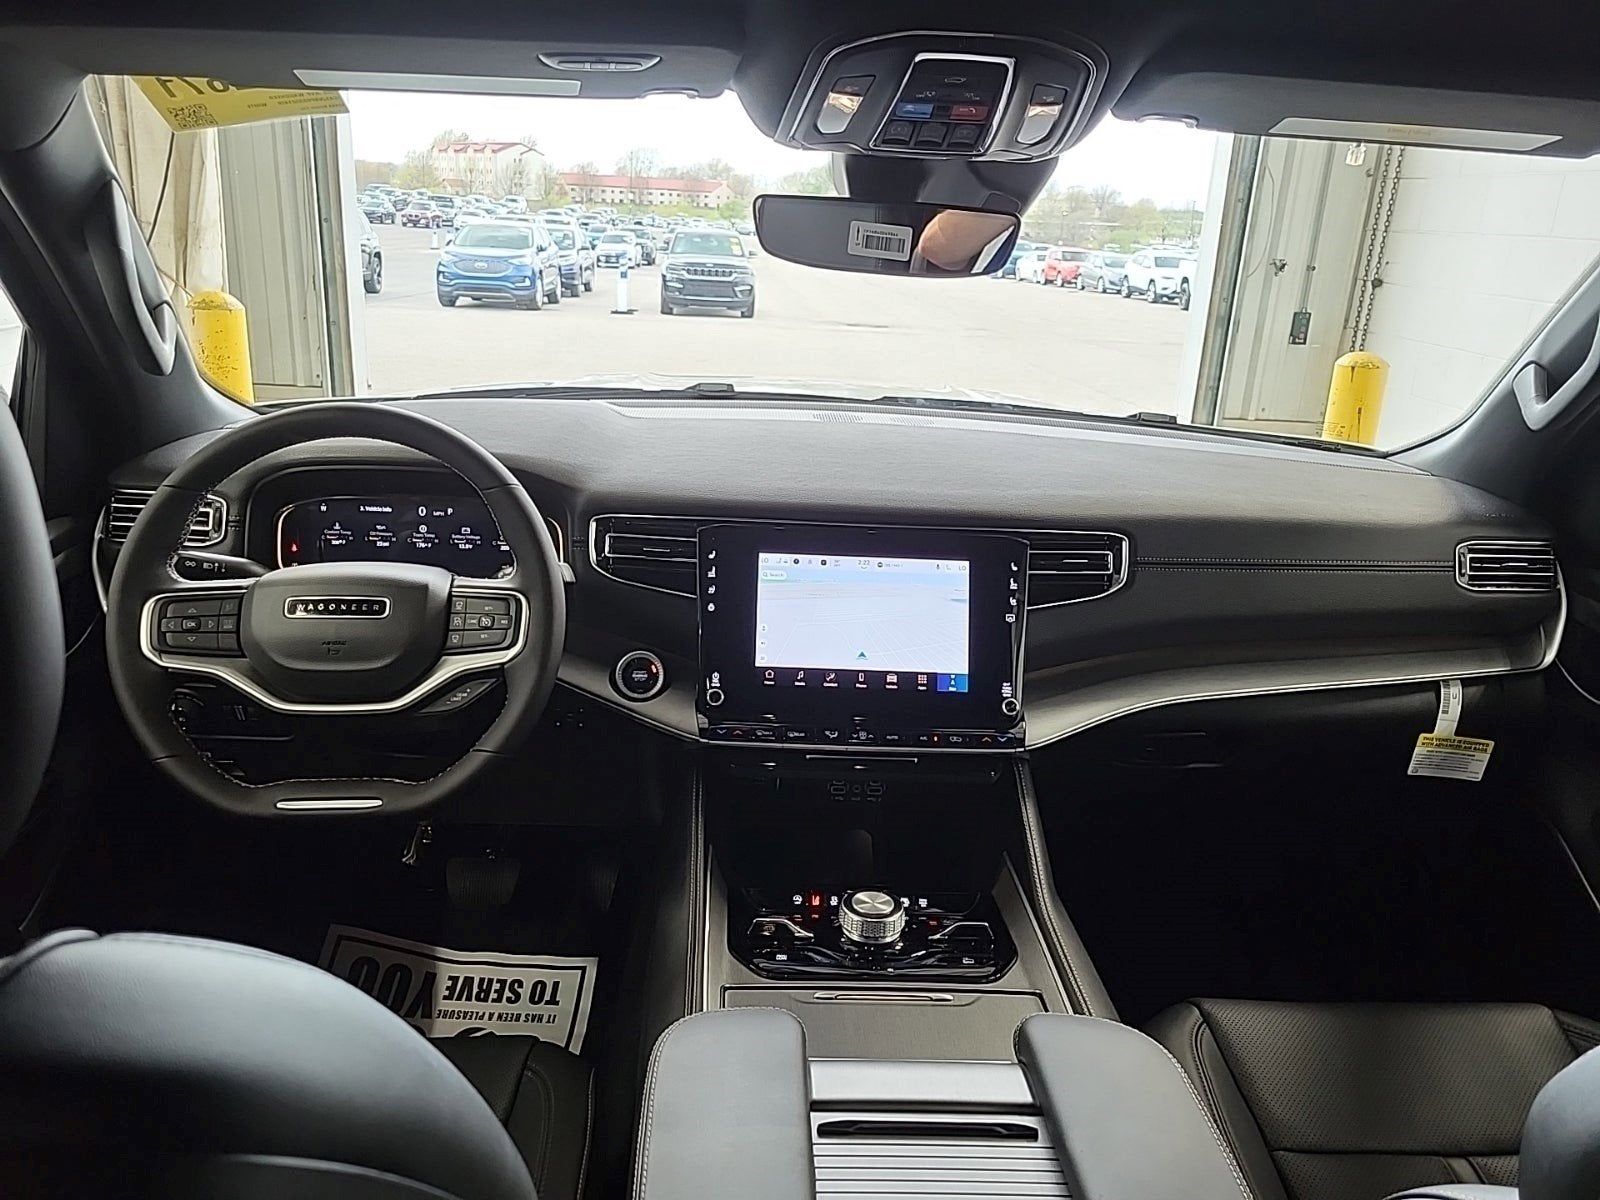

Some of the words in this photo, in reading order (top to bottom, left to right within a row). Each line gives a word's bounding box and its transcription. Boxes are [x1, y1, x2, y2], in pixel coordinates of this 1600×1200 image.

[418, 506, 427, 517] 0
[447, 507, 454, 515] P
[296, 603, 380, 611] WAGONEER
[442, 975, 524, 1005] SERVE
[528, 979, 561, 1006] TO
[436, 1009, 485, 1021] PLEASURE
[487, 1012, 495, 1022] A
[496, 1012, 523, 1023] BEEN
[523, 1013, 544, 1024] HAS
[545, 1014, 557, 1024] IT
